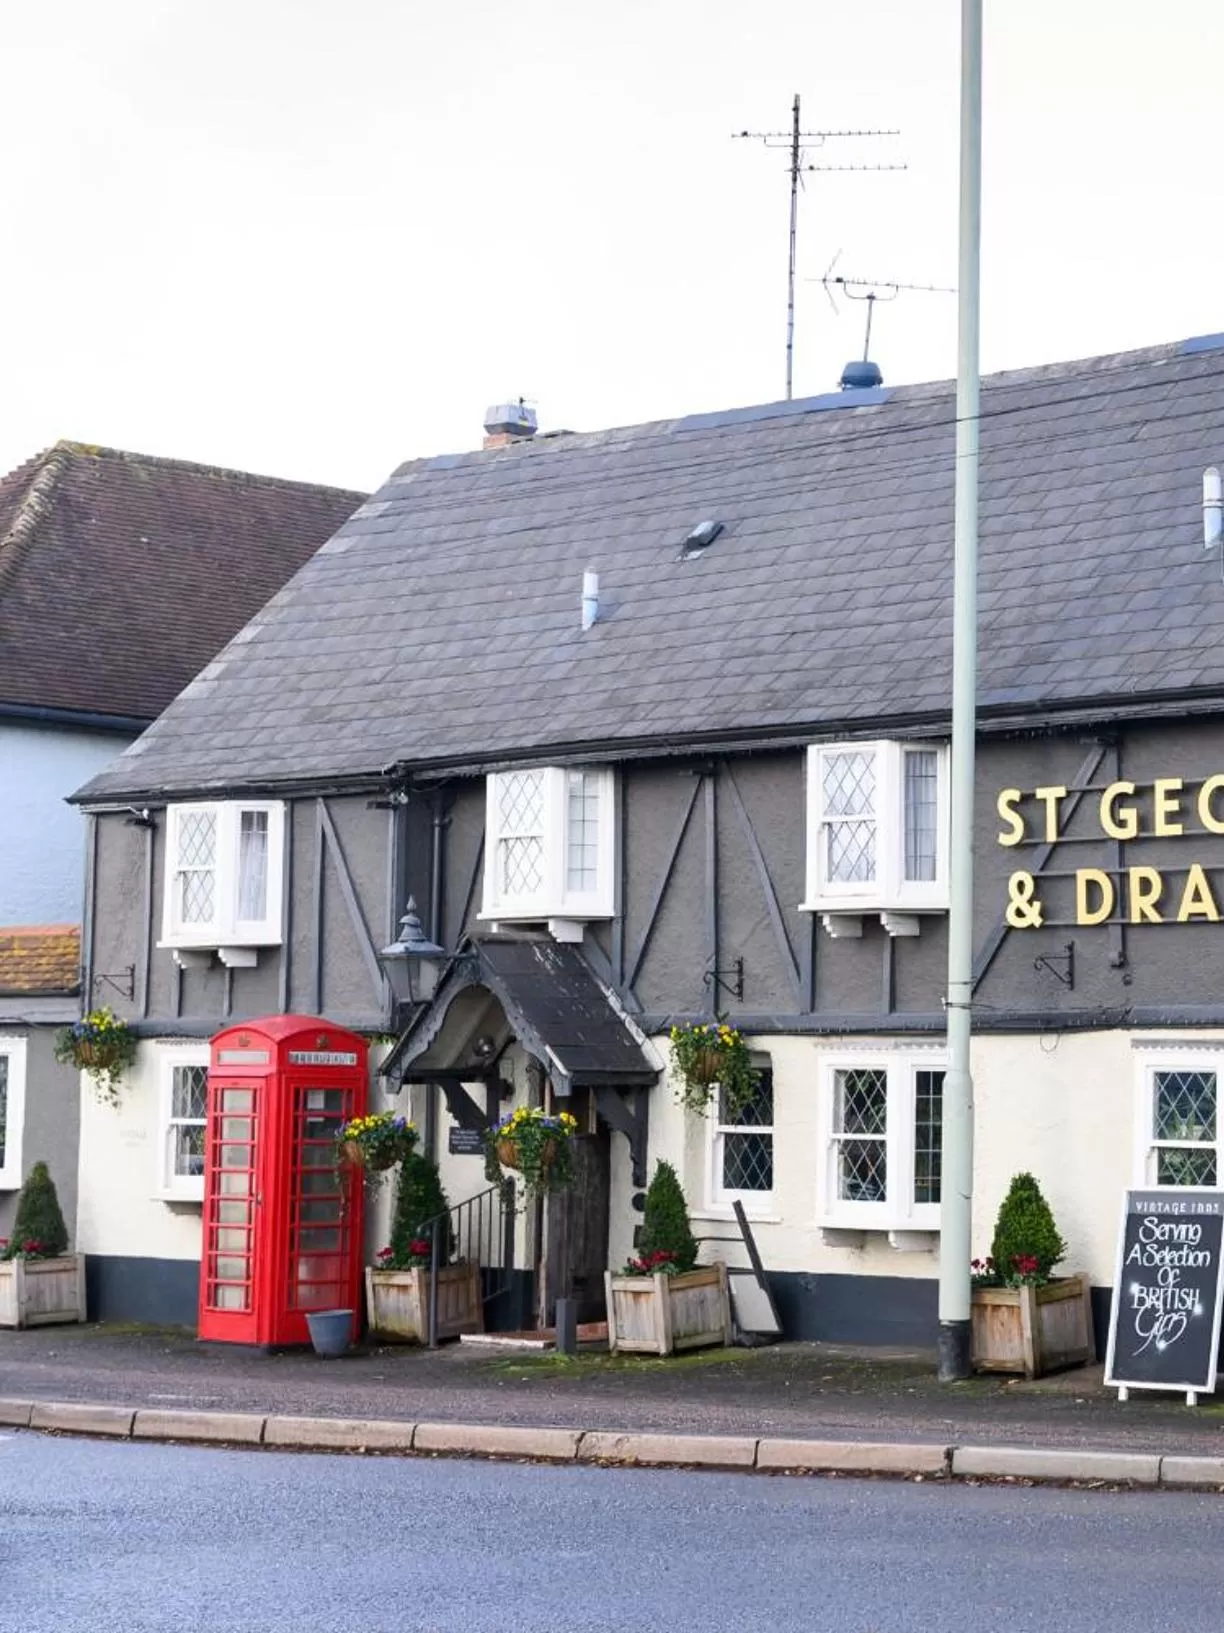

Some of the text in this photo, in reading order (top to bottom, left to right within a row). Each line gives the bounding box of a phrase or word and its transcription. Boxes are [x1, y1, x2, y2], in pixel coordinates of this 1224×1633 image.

[997, 786, 1067, 846] ST
[1005, 870, 1043, 928] &
[1135, 1202, 1187, 1215] VINTAGE
[1139, 1216, 1202, 1245] Serving
[1126, 1243, 1211, 1267] A Selection
[1132, 1285, 1200, 1310] BRITISH
